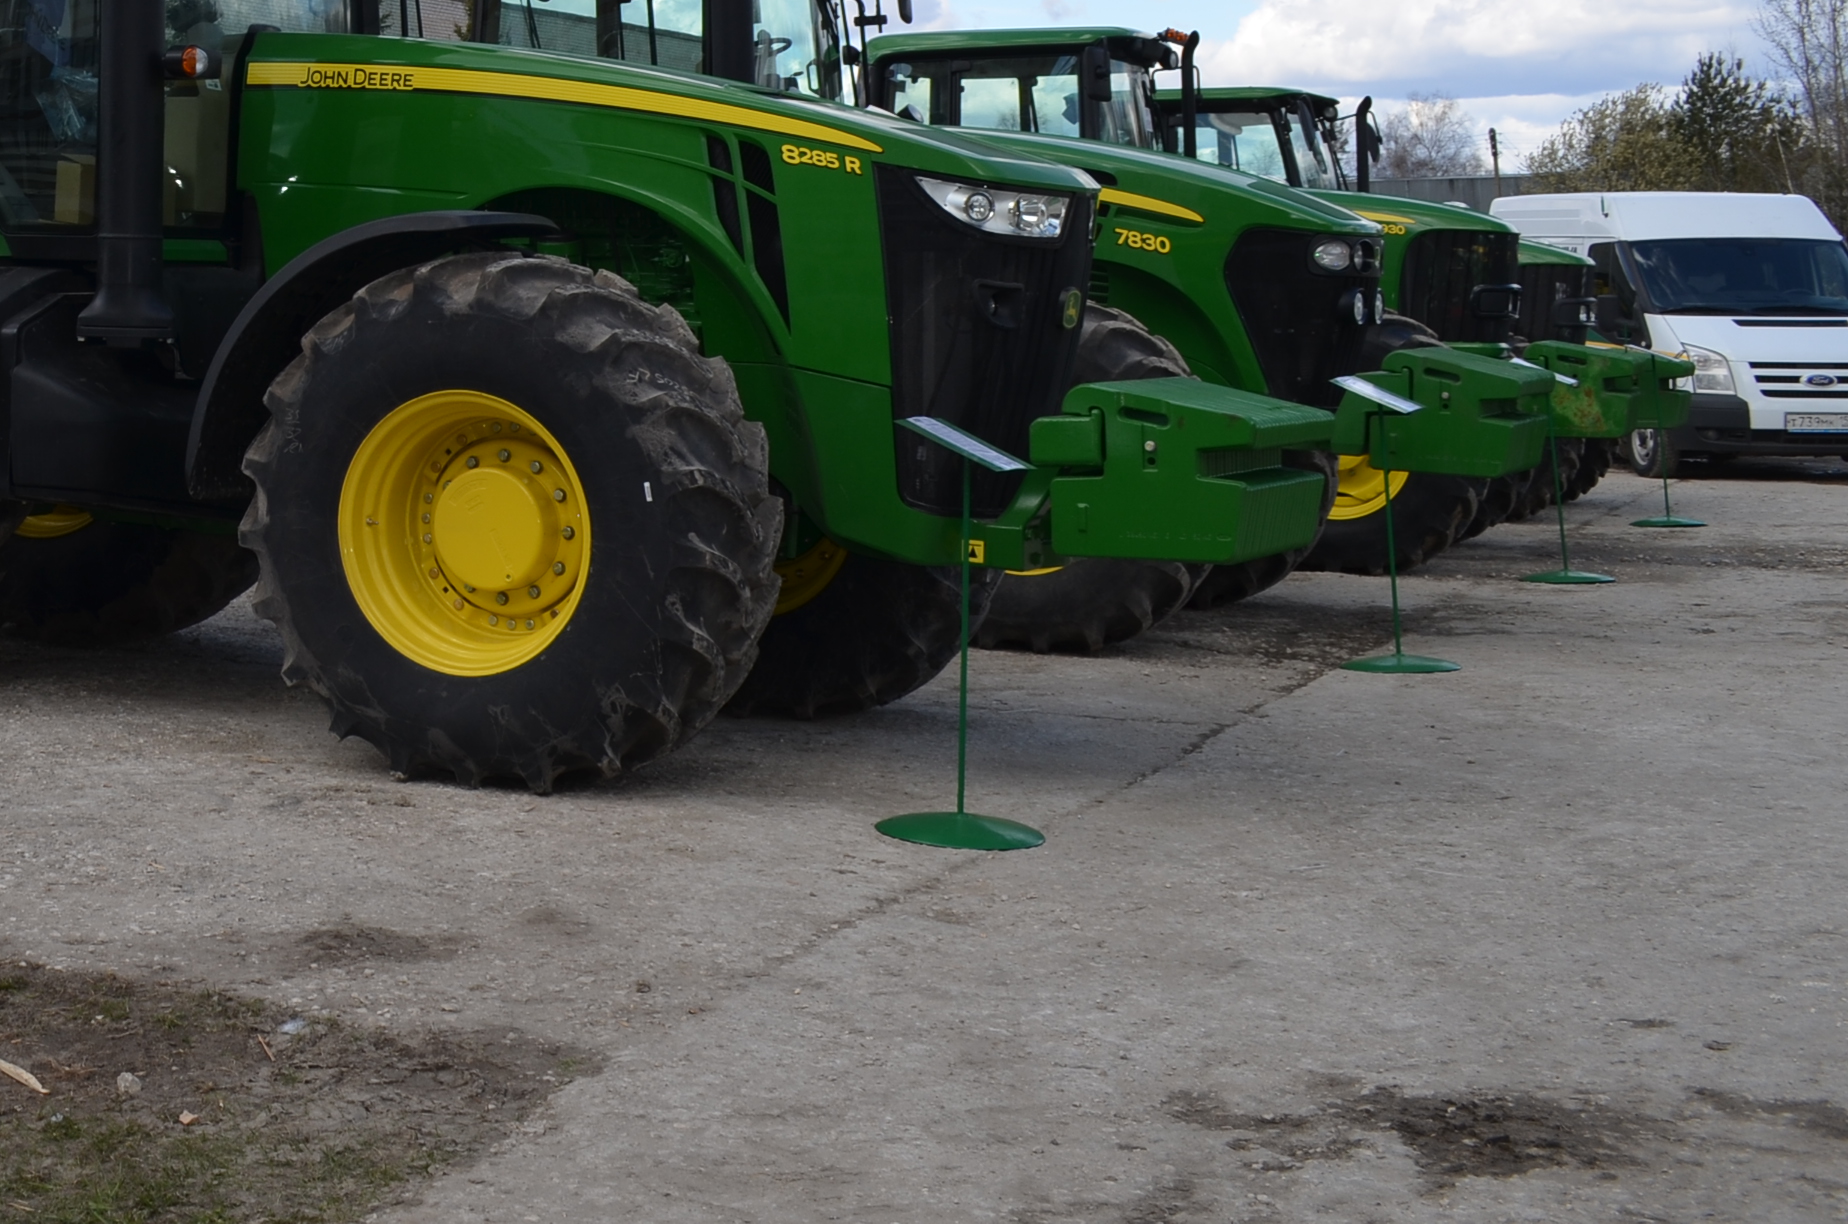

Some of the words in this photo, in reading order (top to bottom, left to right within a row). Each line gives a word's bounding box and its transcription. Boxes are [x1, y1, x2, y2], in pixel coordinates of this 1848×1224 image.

[299, 66, 349, 85] JOHN
[352, 68, 414, 88] DEERE
[780, 143, 841, 170] 8285
[844, 155, 862, 176] R
[1114, 227, 1171, 254] 7830
